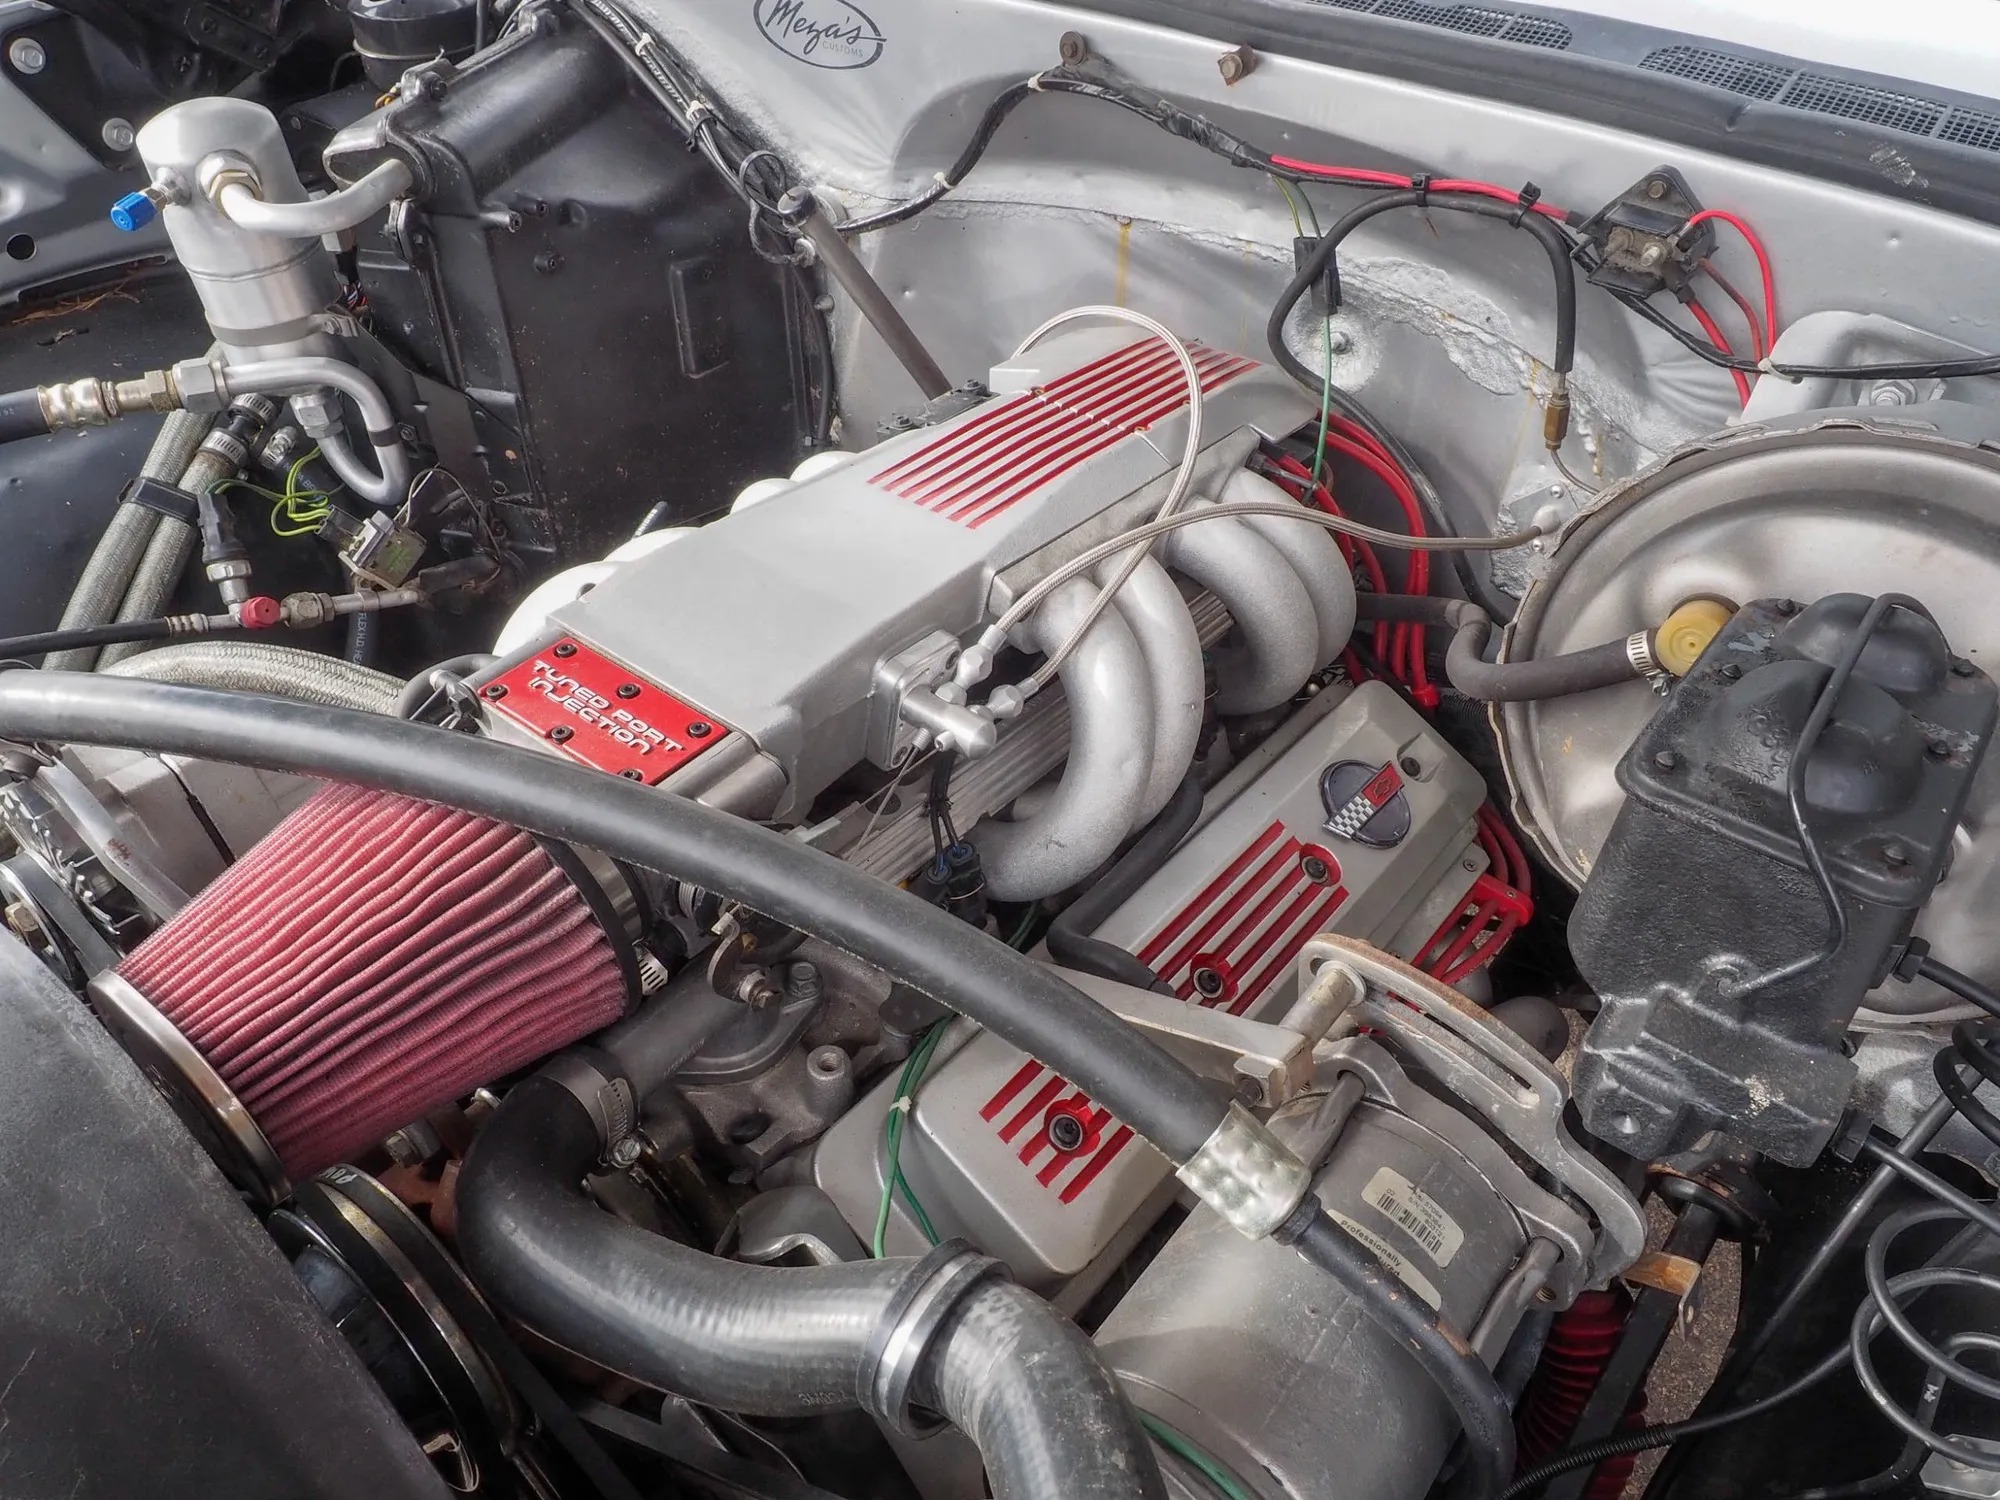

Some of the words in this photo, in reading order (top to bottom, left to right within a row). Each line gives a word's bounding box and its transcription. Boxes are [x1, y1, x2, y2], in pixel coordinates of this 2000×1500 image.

[765, 0, 887, 55] Meza's
[822, 41, 864, 57] CUSTOMS
[529, 677, 651, 755] INJECTION
[533, 660, 612, 711] TUNED
[612, 708, 685, 752] PORT
[1340, 1220, 1401, 1267] Professionally
